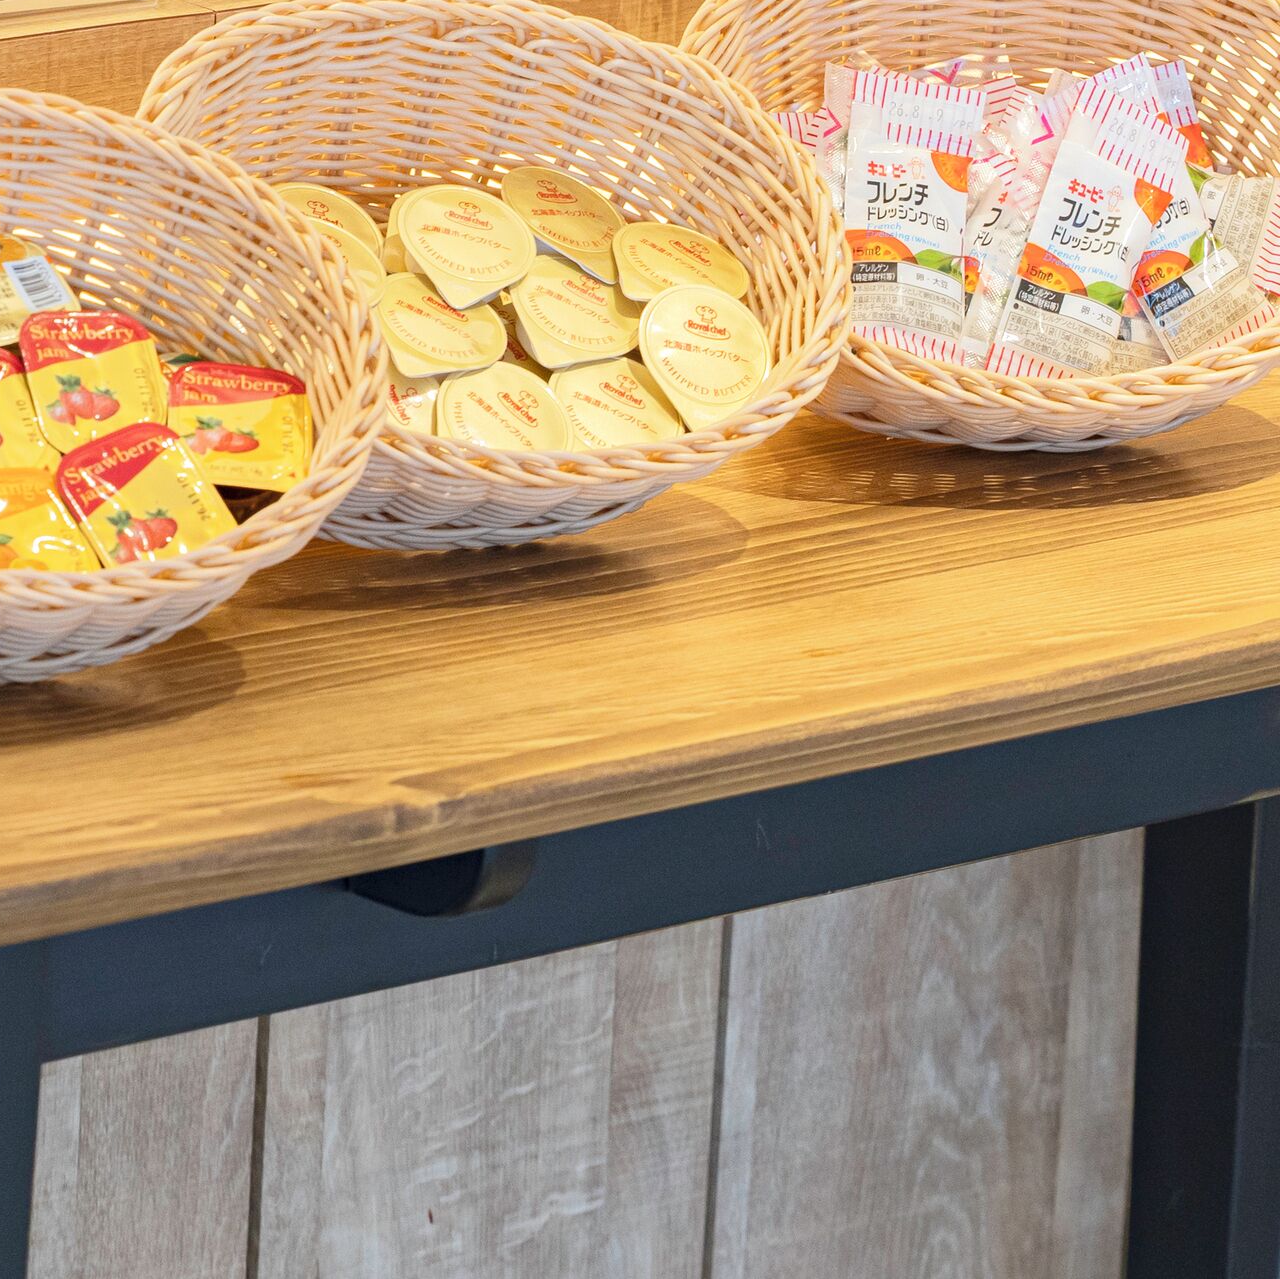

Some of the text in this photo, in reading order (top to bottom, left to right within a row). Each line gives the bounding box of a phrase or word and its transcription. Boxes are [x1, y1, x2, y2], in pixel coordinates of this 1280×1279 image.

[867, 180, 929, 206] フレンチ
[867, 205, 950, 232] ドレッシング(白)
[1058, 197, 1122, 237] フレンチ
[418, 236, 514, 275] WHIPPED BUTTER
[1046, 243, 1081, 262] French
[29, 324, 135, 343] Strawberry
[570, 334, 617, 345] BUTTER
[687, 319, 727, 336] Royal chef
[36, 344, 69, 362] jam
[183, 370, 292, 394] Strawberry
[662, 357, 753, 397] WHIPPED BUTTER
[182, 388, 218, 404] jam
[501, 391, 538, 425] Royal chef
